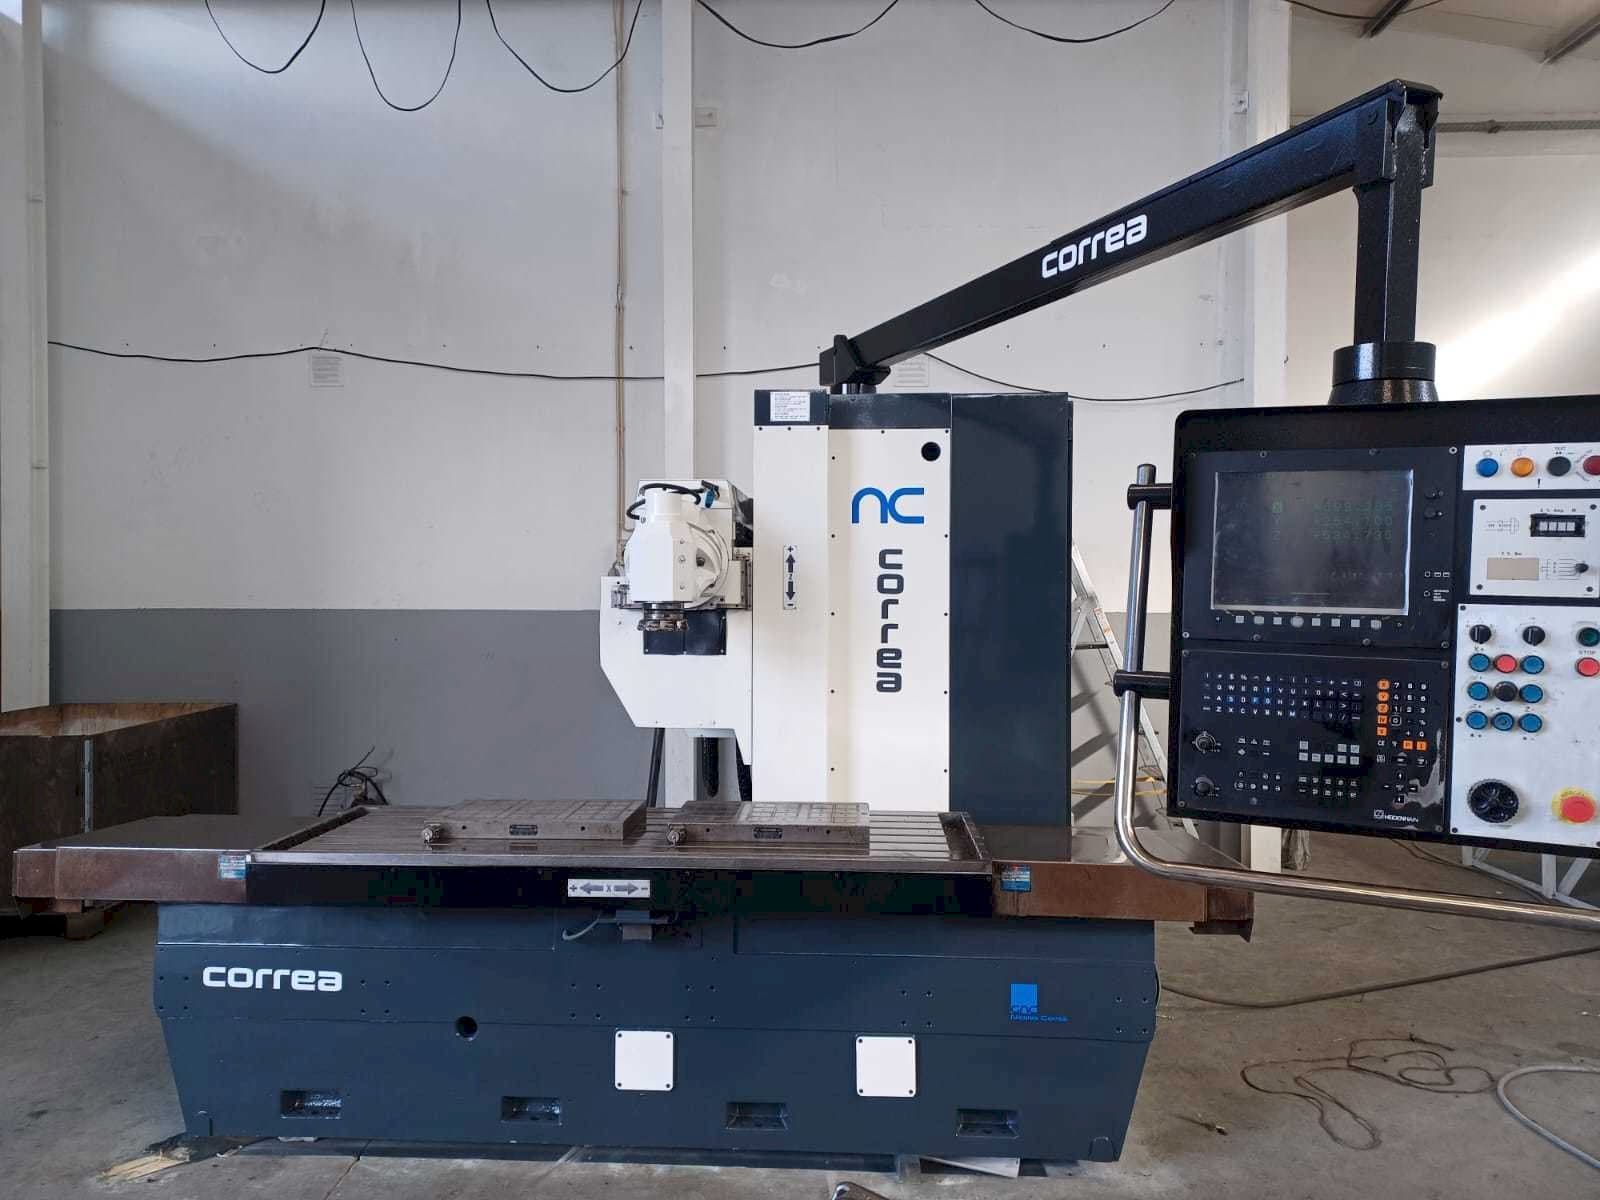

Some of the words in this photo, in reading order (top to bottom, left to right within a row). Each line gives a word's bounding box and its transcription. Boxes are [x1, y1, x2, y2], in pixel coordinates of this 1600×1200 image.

[1041, 213, 1148, 279] correa
[876, 548, 905, 693] correa
[201, 965, 344, 992] correa
